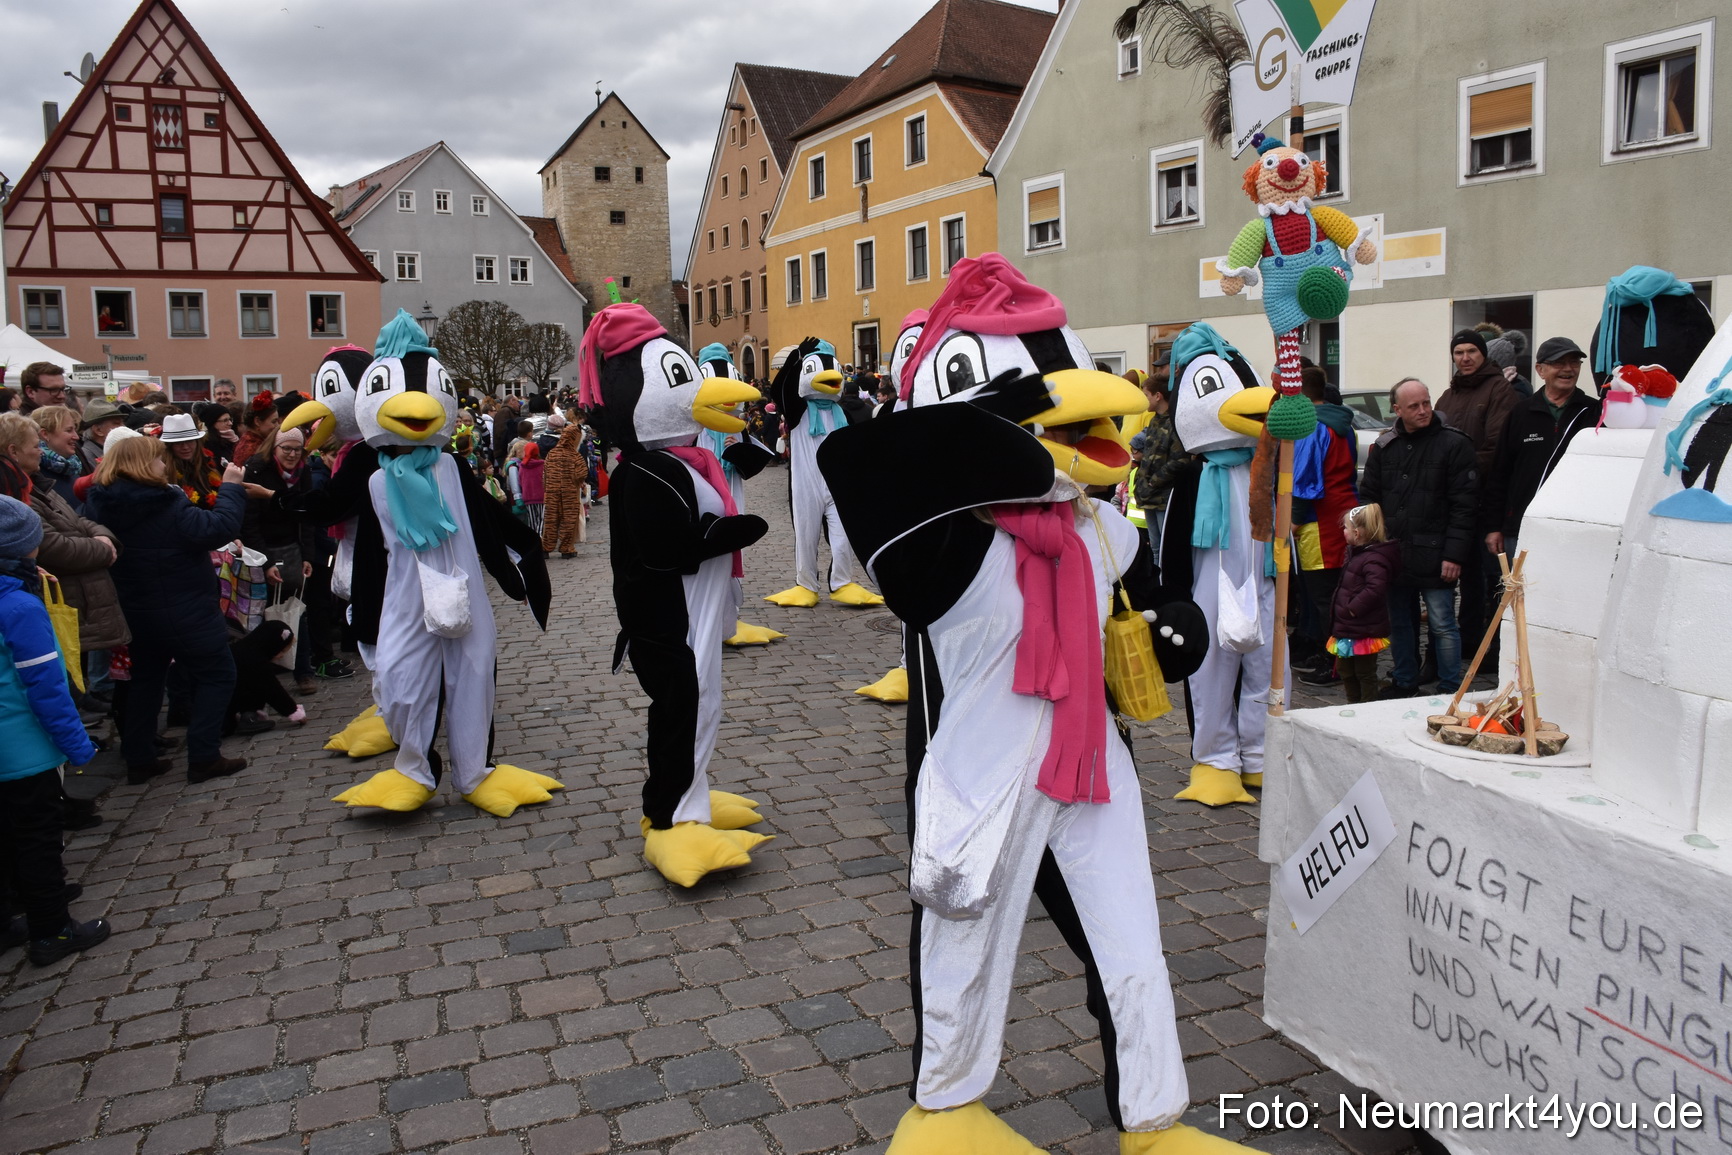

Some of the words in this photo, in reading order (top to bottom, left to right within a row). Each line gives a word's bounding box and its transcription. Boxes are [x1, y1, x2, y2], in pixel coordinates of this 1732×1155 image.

[1255, 27, 1287, 91] G
[1264, 65, 1280, 80] SKMJ
[1306, 32, 1363, 63] FASCHINGS-
[1315, 58, 1352, 81] GRUPPE
[1237, 119, 1262, 148] Berching
[1299, 805, 1369, 899] HELAU
[1407, 821, 1543, 913] FOLGT
[1406, 883, 1561, 989] INNEREN
[1408, 937, 1476, 998] UND
[1412, 992, 1550, 1093] DURCH'S
